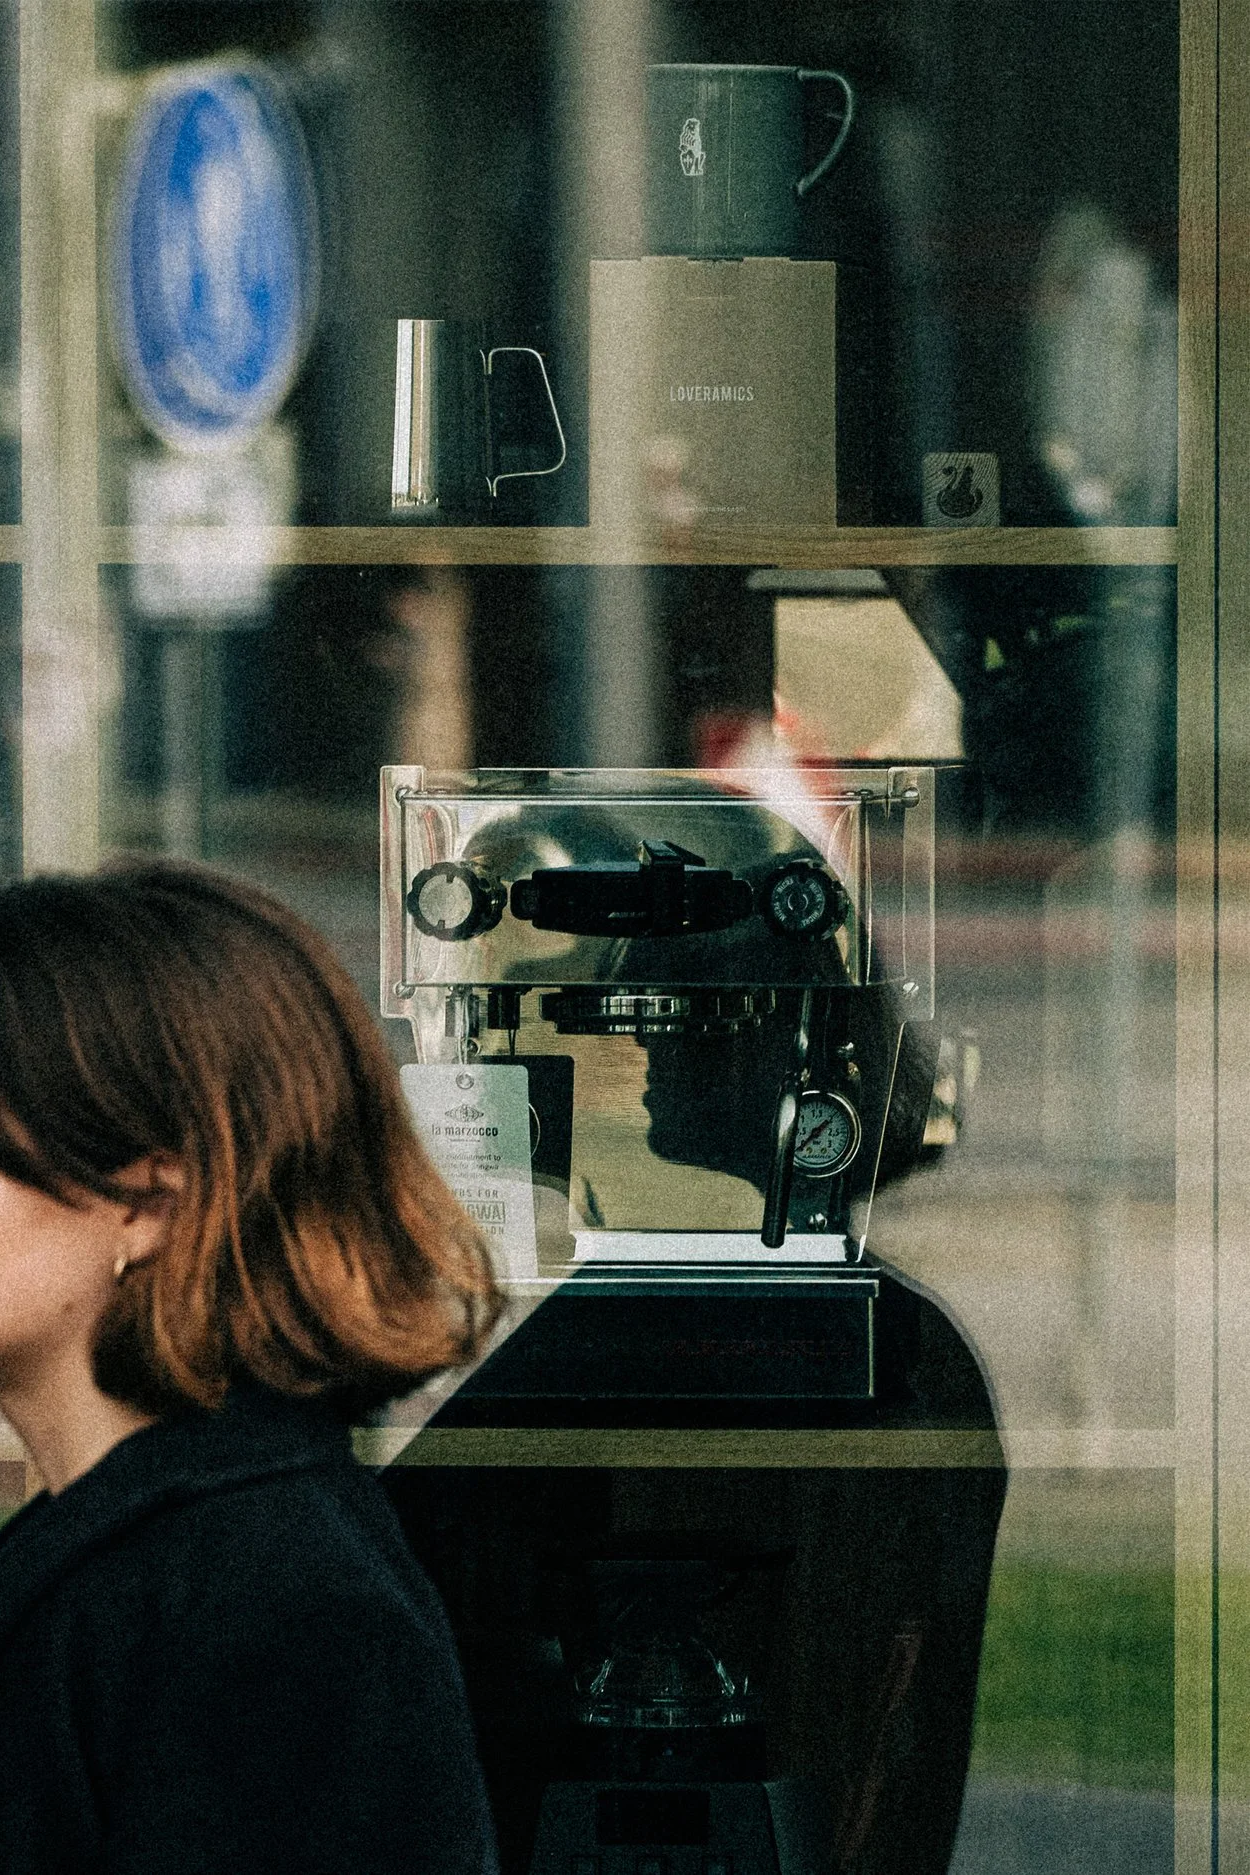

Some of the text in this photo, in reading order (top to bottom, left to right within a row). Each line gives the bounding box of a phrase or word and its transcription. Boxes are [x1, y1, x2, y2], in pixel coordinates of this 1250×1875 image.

[669, 385, 755, 402] LOVERAMICS
[431, 1123, 499, 1137] la marzocco
[493, 1153, 502, 1162] to
[478, 1189, 499, 1199] FOR
